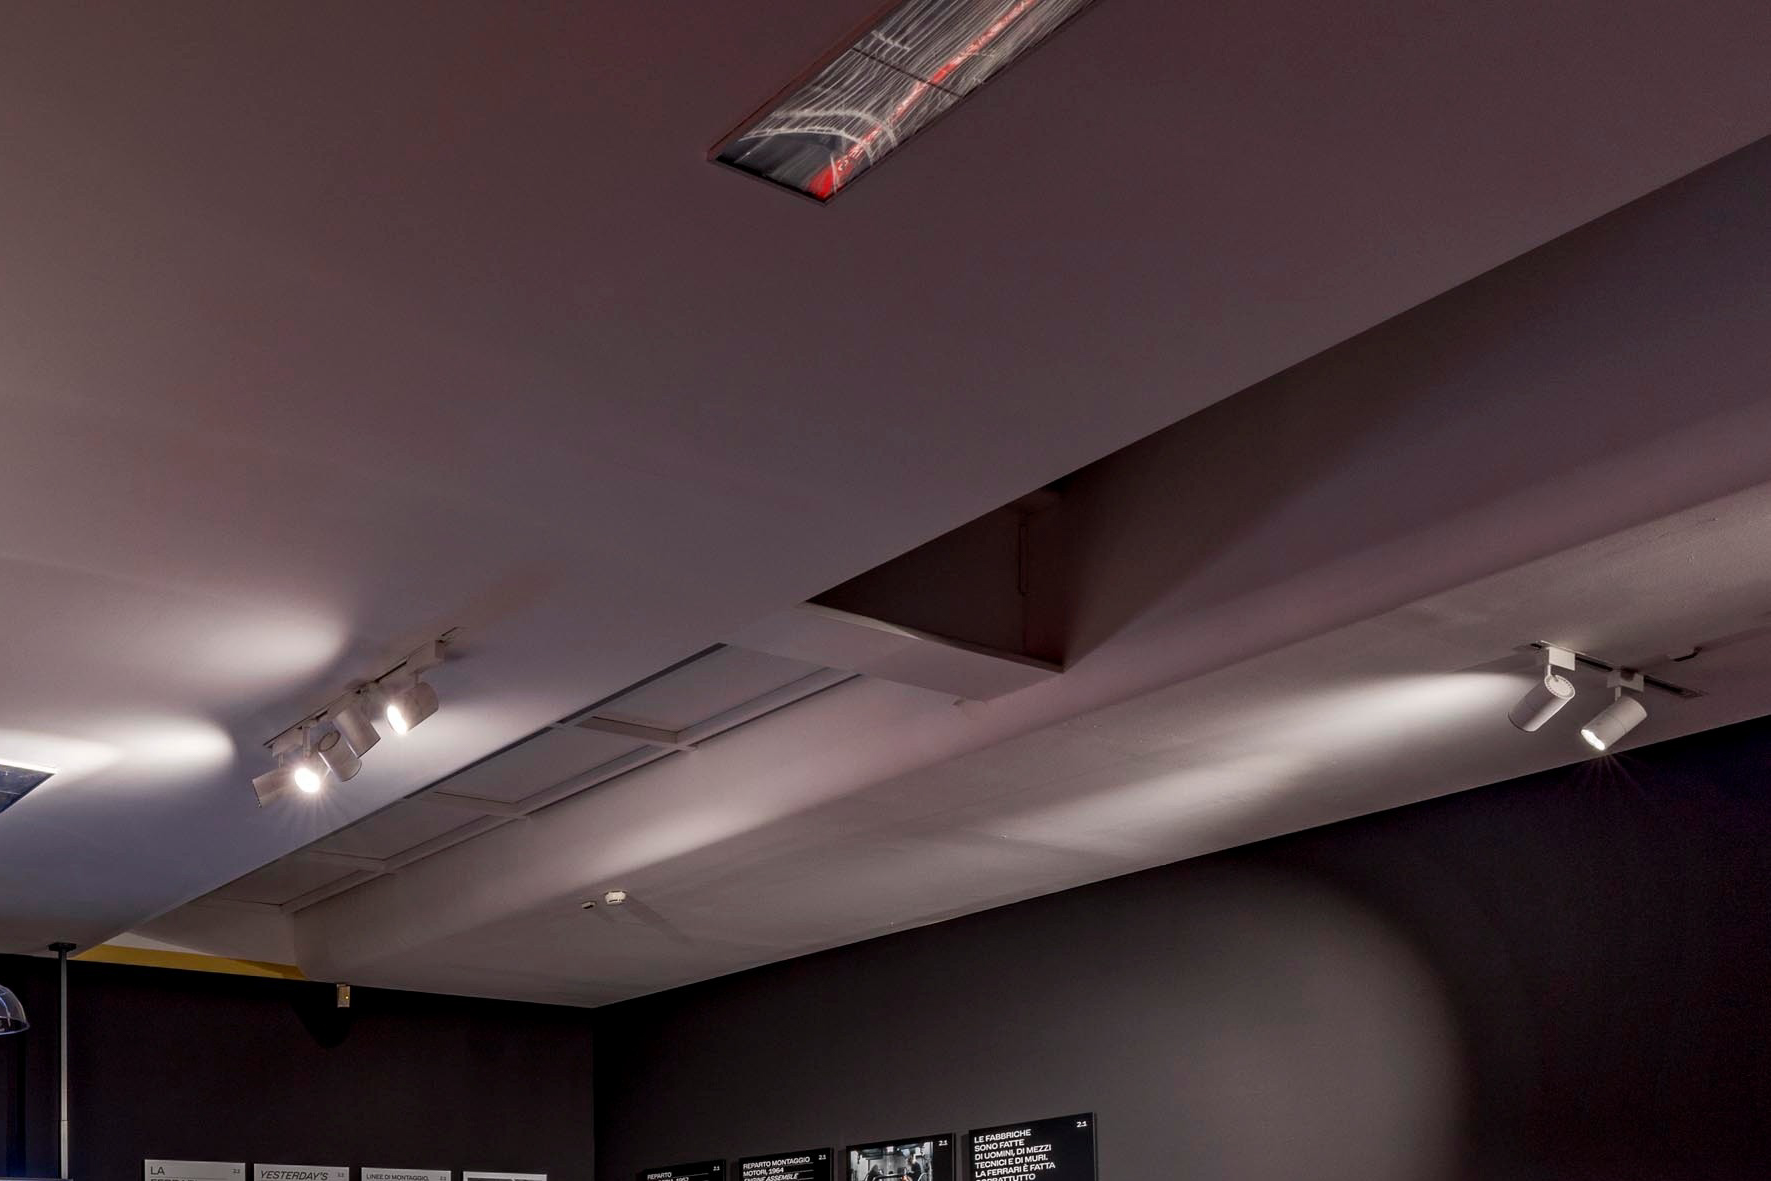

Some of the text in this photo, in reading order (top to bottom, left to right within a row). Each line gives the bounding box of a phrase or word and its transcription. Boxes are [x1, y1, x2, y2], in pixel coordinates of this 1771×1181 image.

[986, 1129, 1031, 1142] FABBRICHE
[974, 1139, 1024, 1152] SONO FATTE
[984, 1149, 1015, 1159] UOMINI,
[1026, 1144, 1051, 1153] MEZZI
[743, 1156, 810, 1170] REPARTO MONTAGGIO
[975, 1159, 1007, 1169] TECNICI
[1015, 1156, 1023, 1164] DI
[1025, 1154, 1048, 1162] MURI.
[150, 1166, 165, 1175] LA
[260, 1170, 328, 1181] YESTERDAY'S
[647, 1172, 672, 1180] REPARTO
[769, 1167, 784, 1175] 1964
[975, 1162, 1055, 1178] LA FERRARI È FATTA
